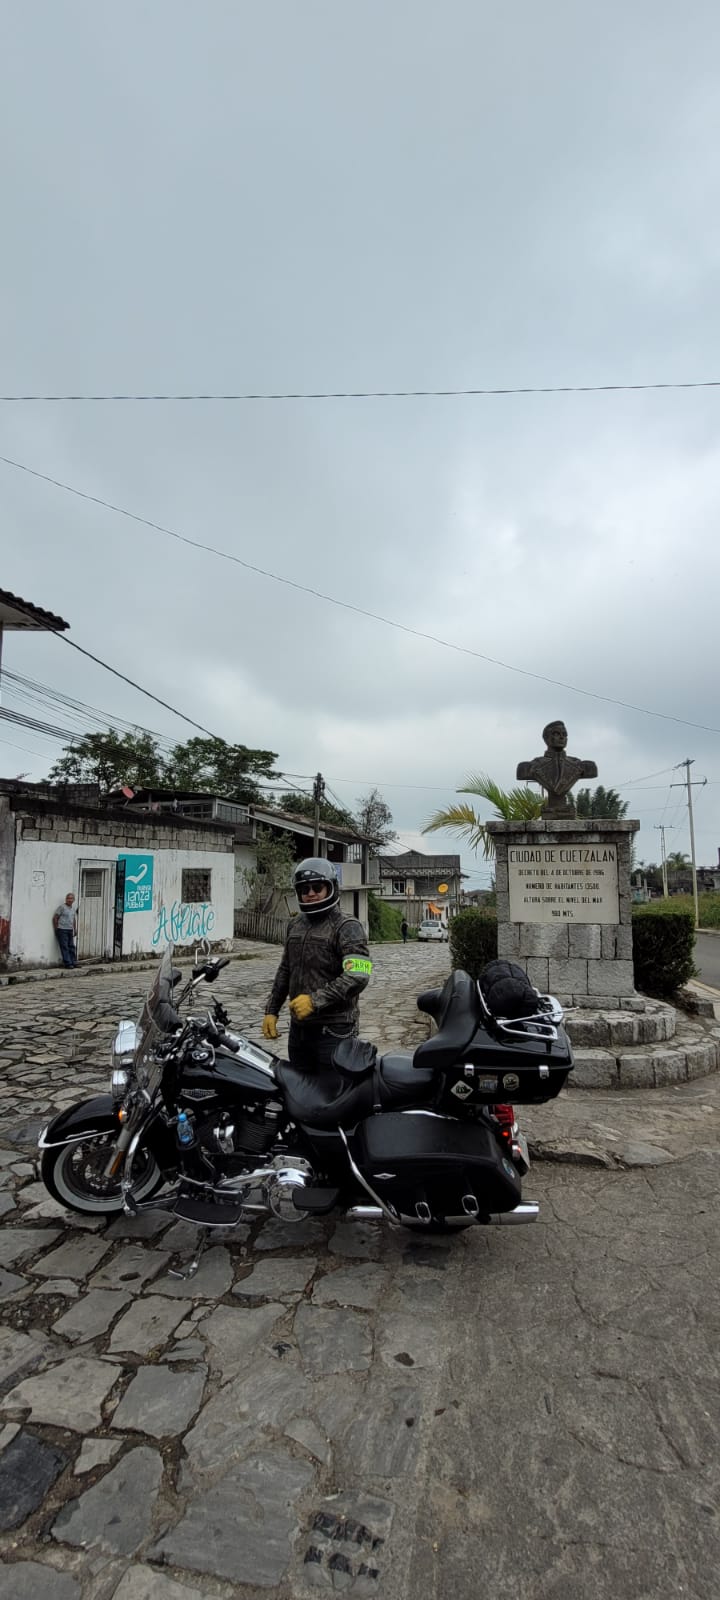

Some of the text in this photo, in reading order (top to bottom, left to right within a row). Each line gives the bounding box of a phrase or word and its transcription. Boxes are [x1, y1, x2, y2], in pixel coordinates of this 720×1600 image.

[510, 850, 615, 862] CIUDAD DE CUETZALAN
